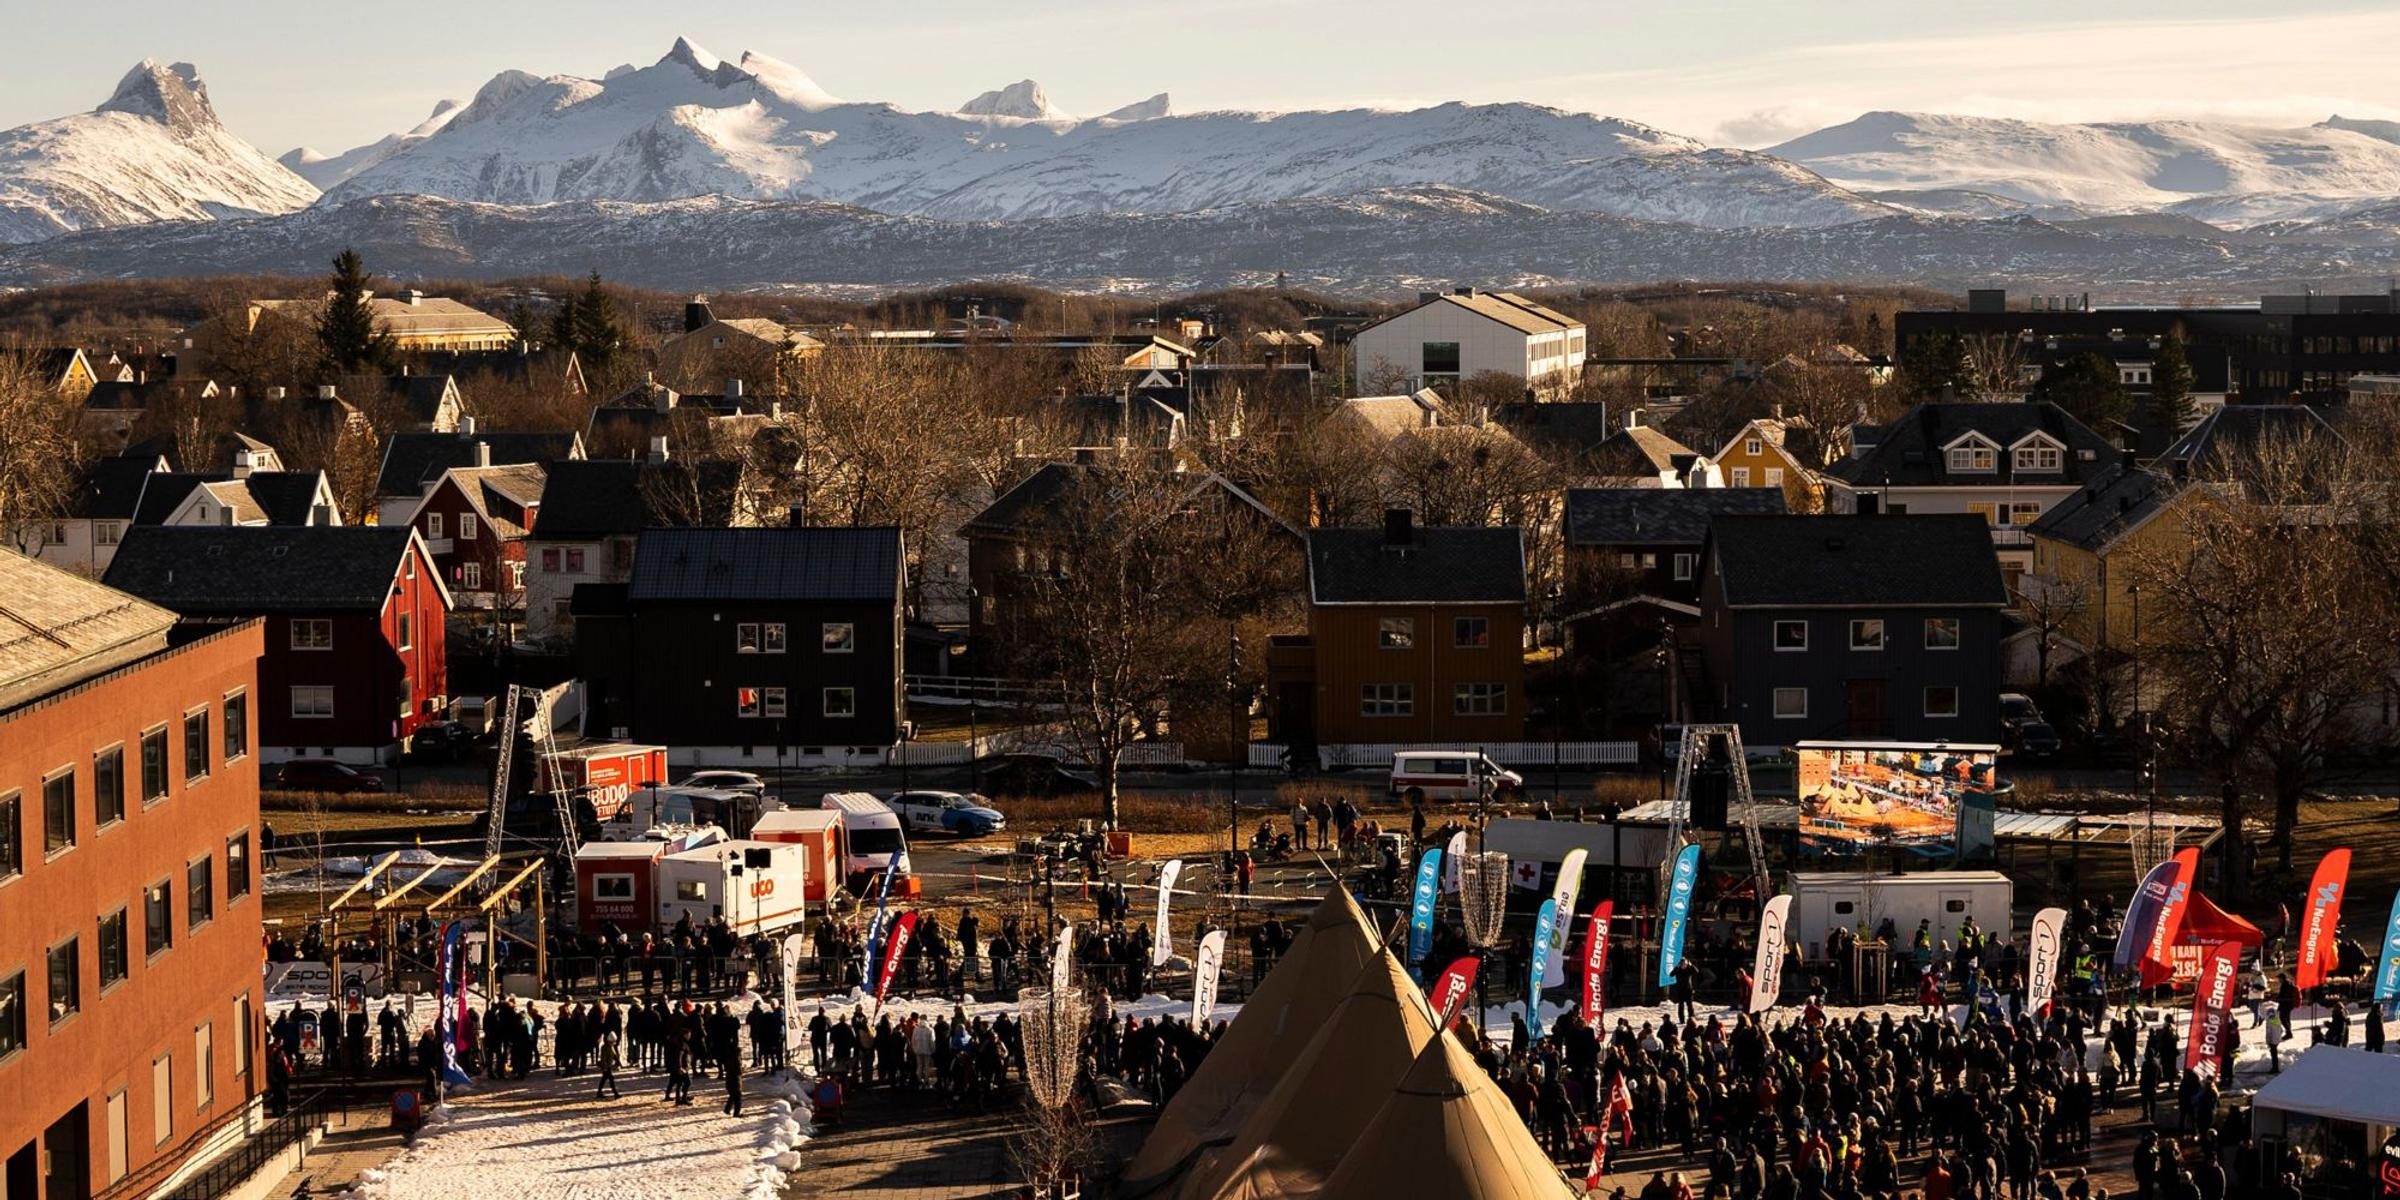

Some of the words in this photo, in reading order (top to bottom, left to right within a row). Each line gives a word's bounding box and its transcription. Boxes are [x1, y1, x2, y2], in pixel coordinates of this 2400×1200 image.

[591, 782, 628, 807] BODØ
[1589, 917, 1607, 970] Energi
[2152, 906, 2172, 963] NorEngros
[2305, 907, 2325, 965] NorEngros
[1761, 938, 1776, 993] sport
[2032, 946, 2048, 998] sport
[2207, 956, 2233, 1010] Energi
[2199, 1013, 2220, 1056] Bodø
